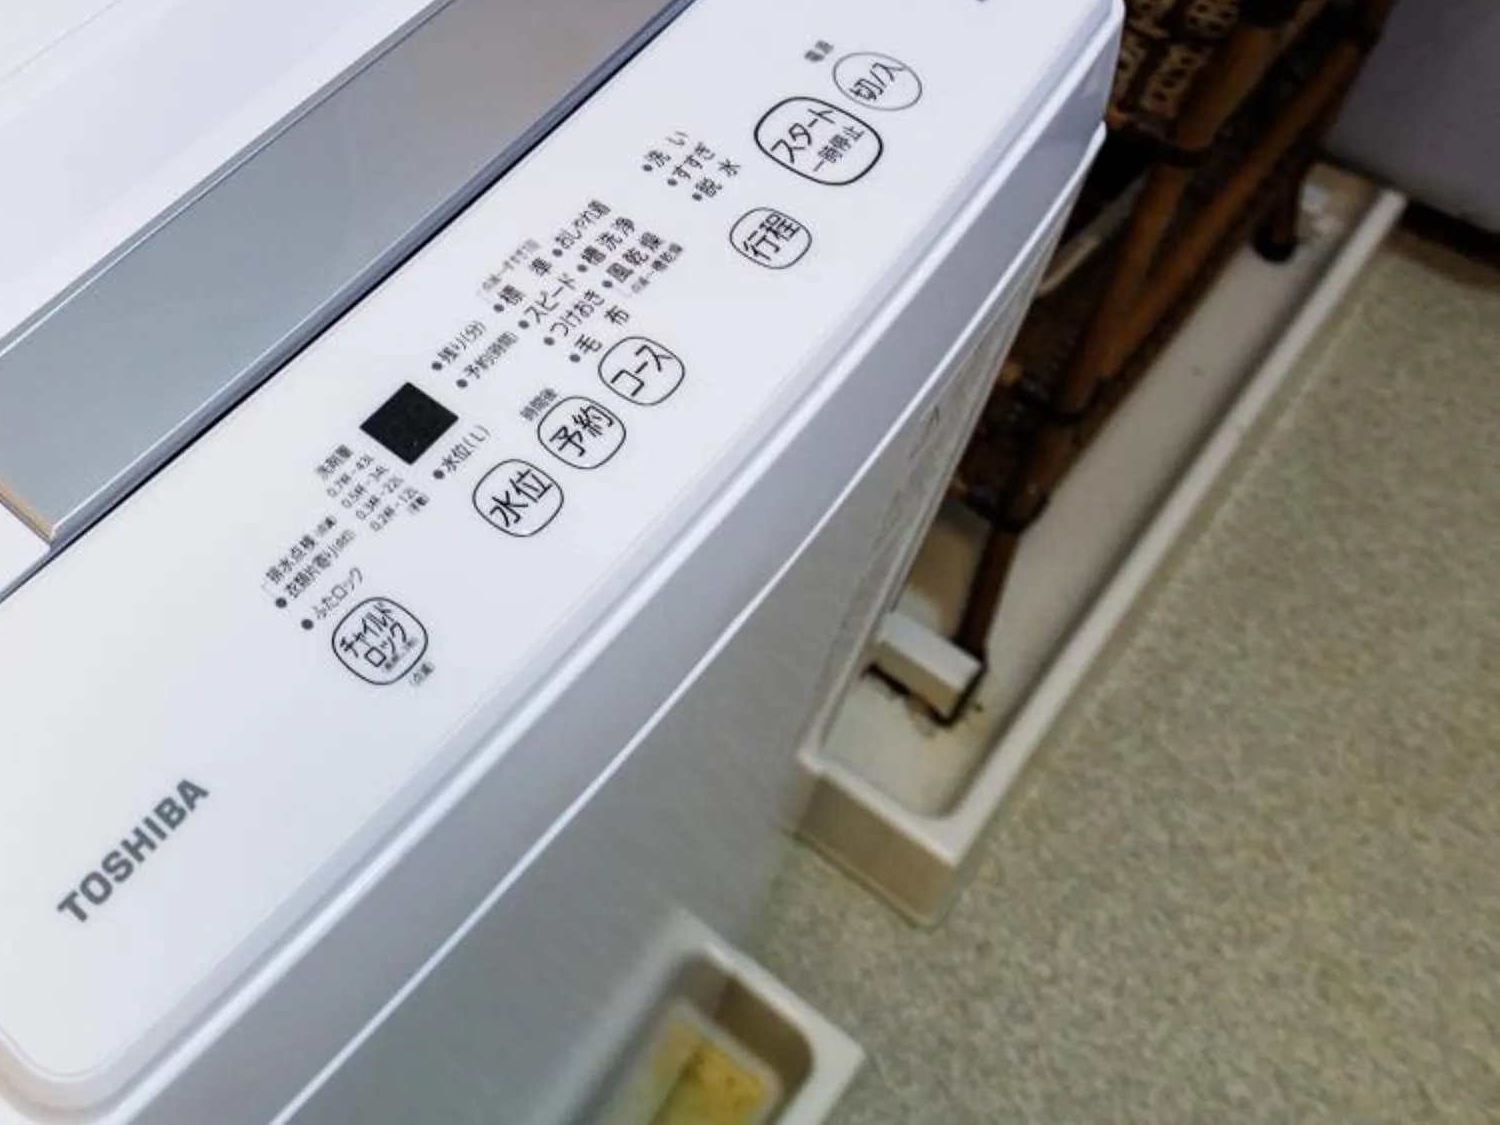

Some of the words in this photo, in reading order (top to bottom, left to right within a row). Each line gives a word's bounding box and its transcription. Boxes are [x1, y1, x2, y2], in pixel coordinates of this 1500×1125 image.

[770, 108, 835, 163] スタート
[813, 125, 865, 172] 一時停止
[672, 142, 715, 180] すすぎ
[695, 159, 740, 197] 脱水
[554, 199, 611, 249] おしゃれ着
[581, 216, 635, 266] 槽洗浄
[743, 212, 800, 261] 行程
[523, 272, 576, 323] スピード
[550, 289, 605, 337] つけおき
[574, 305, 630, 354] 毛布
[610, 344, 673, 397] コース
[549, 404, 614, 457] 予約
[489, 469, 553, 527] 水位
[313, 567, 363, 620] ふたロック
[340, 602, 393, 657] チャイルド
[364, 622, 407, 668] ロック
[56, 779, 209, 923] TOSHIBA
